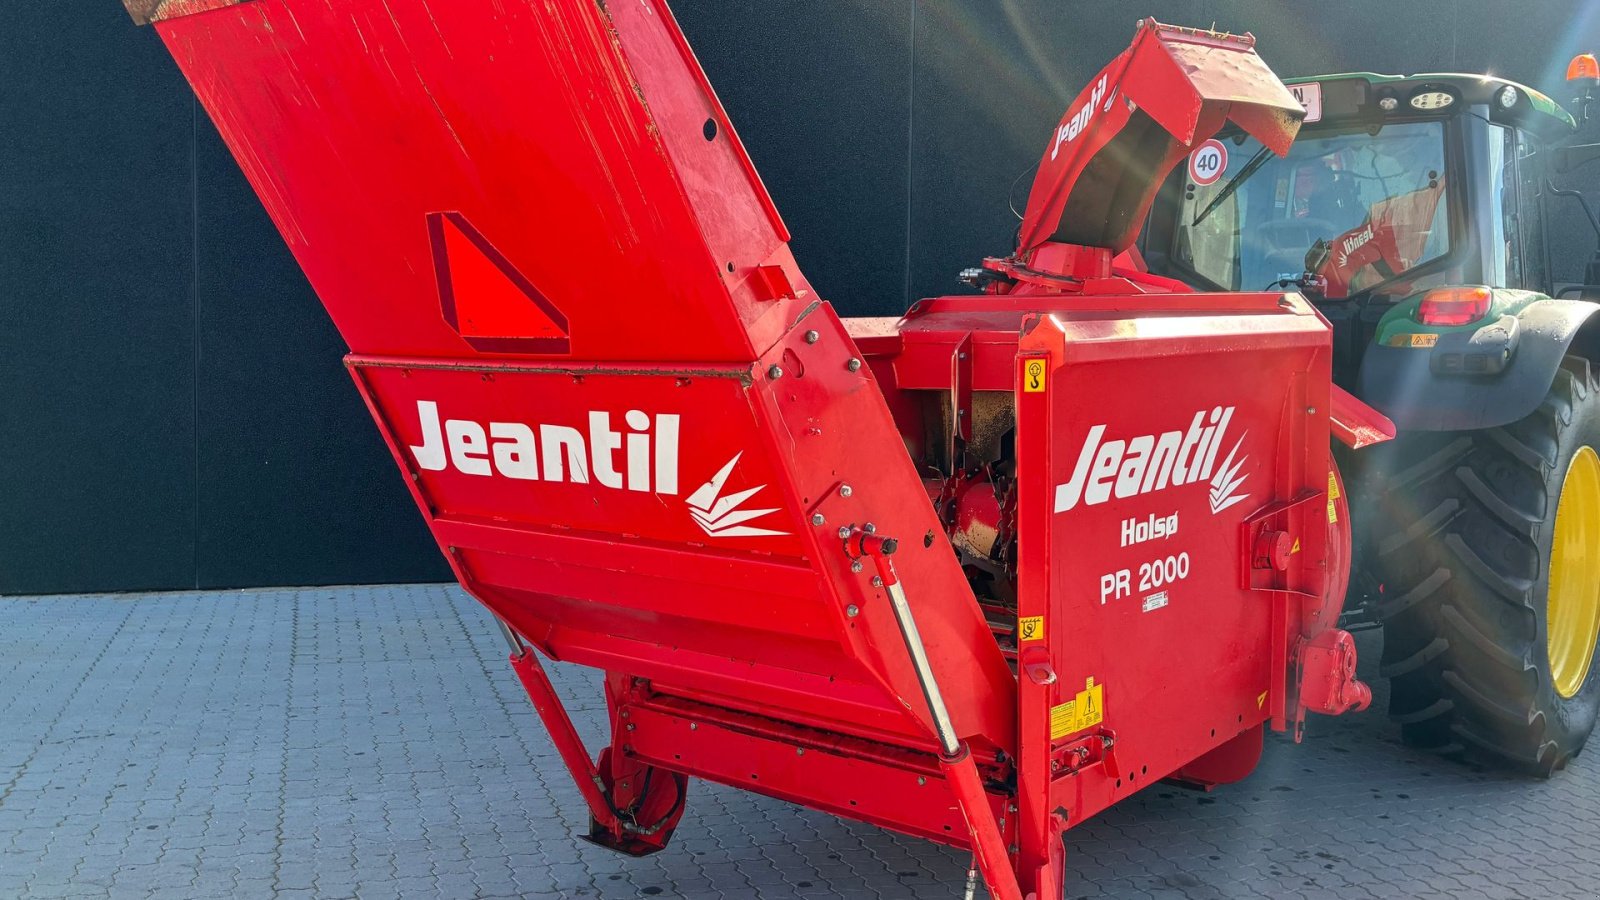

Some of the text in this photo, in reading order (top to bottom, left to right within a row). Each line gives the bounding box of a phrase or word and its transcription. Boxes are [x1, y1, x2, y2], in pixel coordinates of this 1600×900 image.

[1051, 73, 1107, 160] Jeantil
[1197, 153, 1218, 171] 40
[409, 400, 680, 495] Jeantil
[1054, 406, 1235, 514] Jeantil
[1121, 510, 1179, 547] Holsø
[1101, 569, 1130, 604] PR
[1139, 552, 1189, 592] 2000
